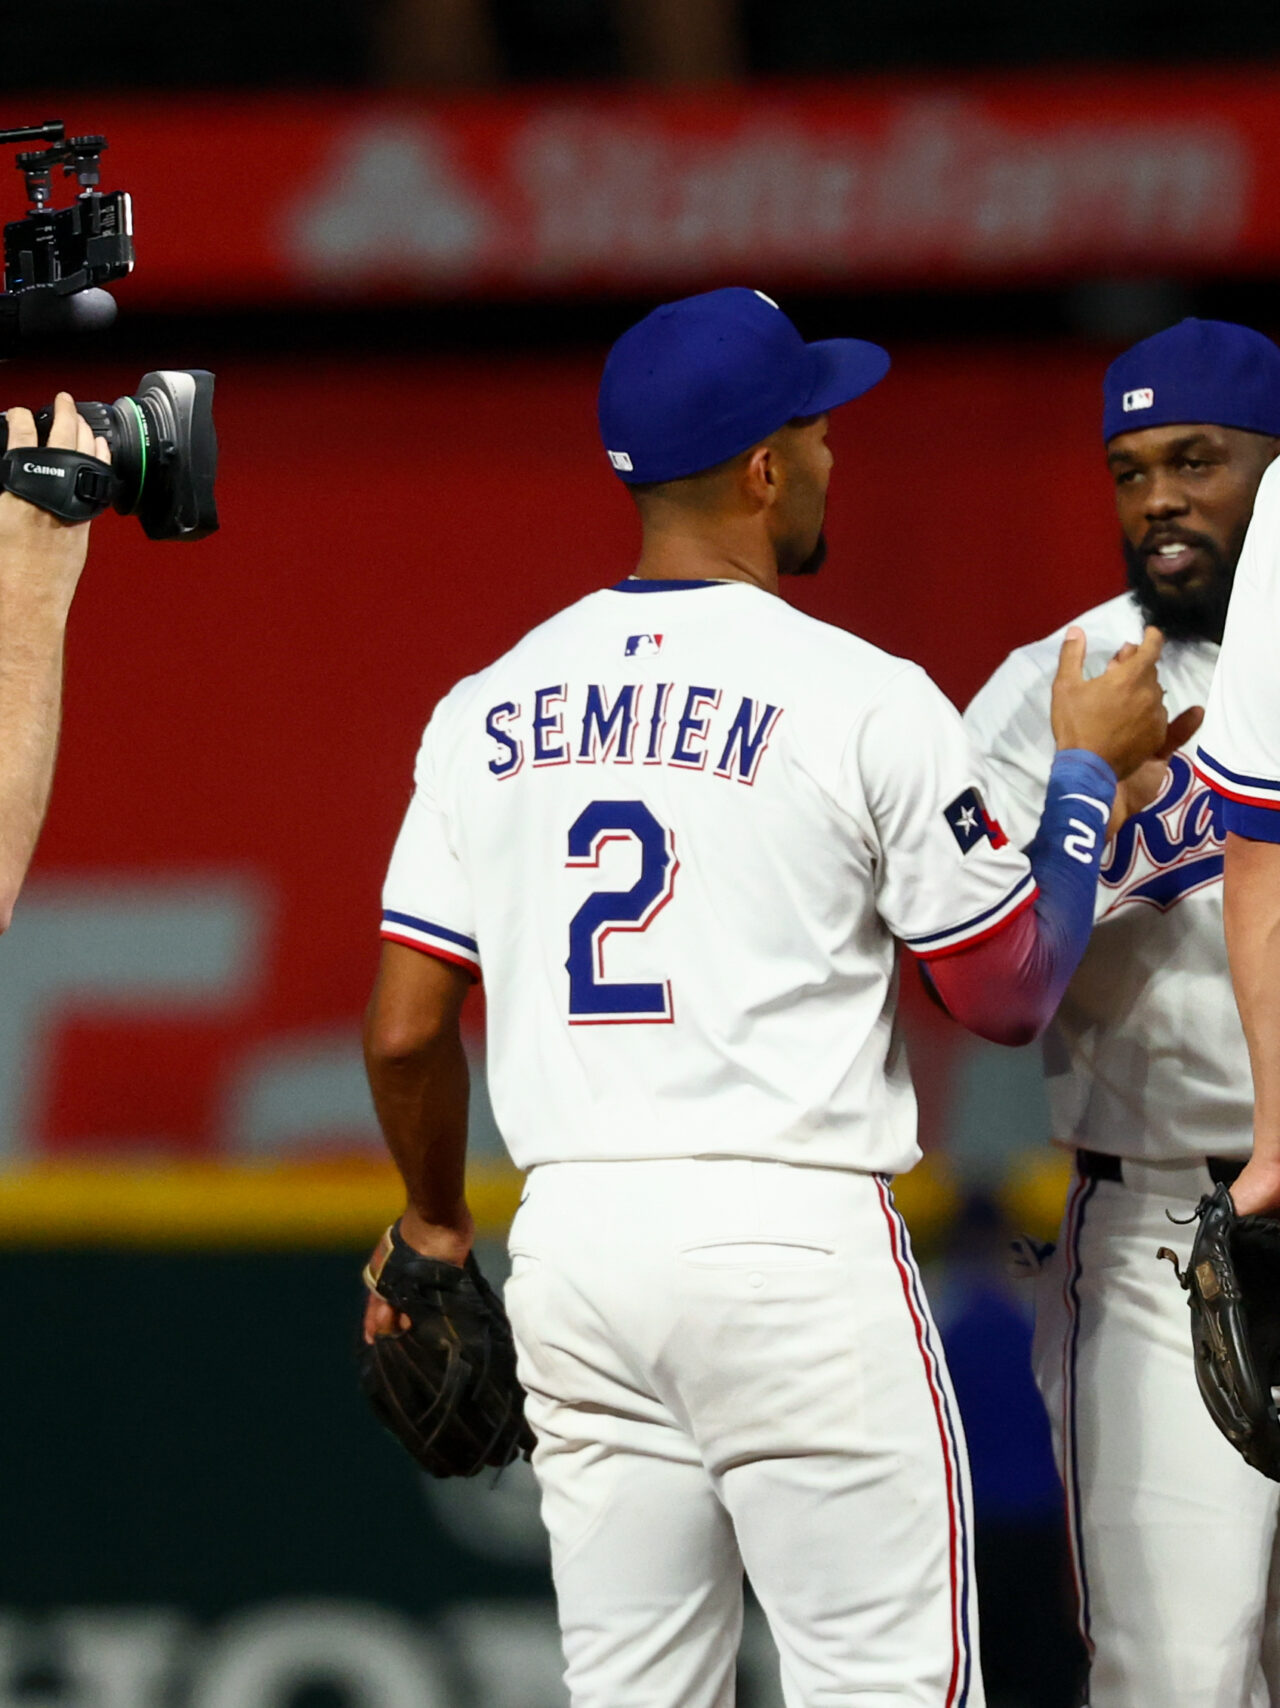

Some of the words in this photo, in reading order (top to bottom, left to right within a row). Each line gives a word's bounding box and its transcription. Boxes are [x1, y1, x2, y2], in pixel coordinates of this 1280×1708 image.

[22, 462, 66, 478] Canon
[485, 682, 784, 787] SEMIEN
[564, 799, 681, 1026] 2
